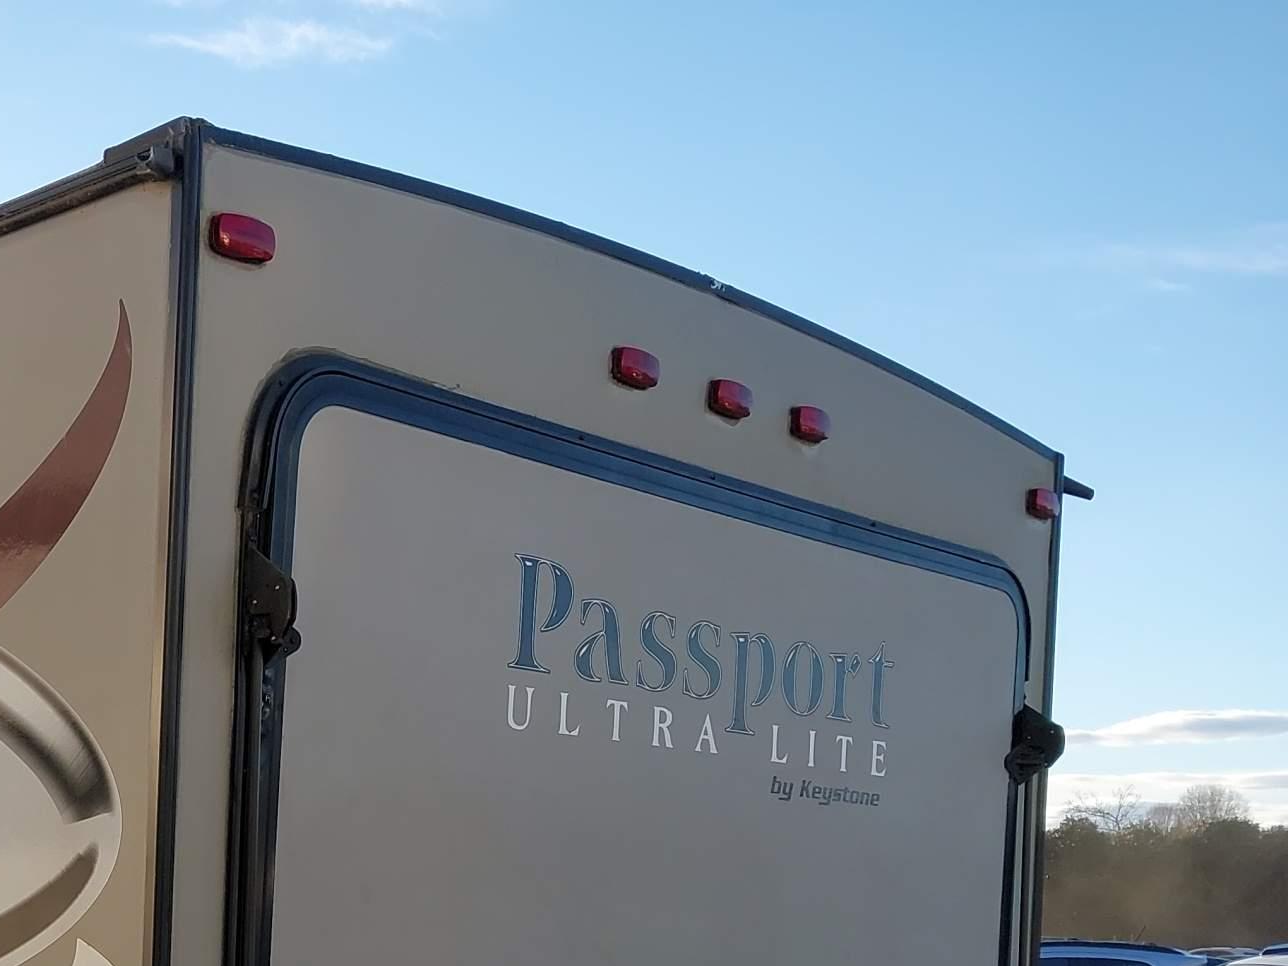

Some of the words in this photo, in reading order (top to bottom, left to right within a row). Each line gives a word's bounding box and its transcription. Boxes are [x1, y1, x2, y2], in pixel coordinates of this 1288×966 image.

[507, 552, 895, 735] Passport
[507, 684, 719, 754] ULTRA
[769, 724, 888, 777] LITE
[770, 776, 794, 801] by
[799, 779, 881, 807] Keystone
